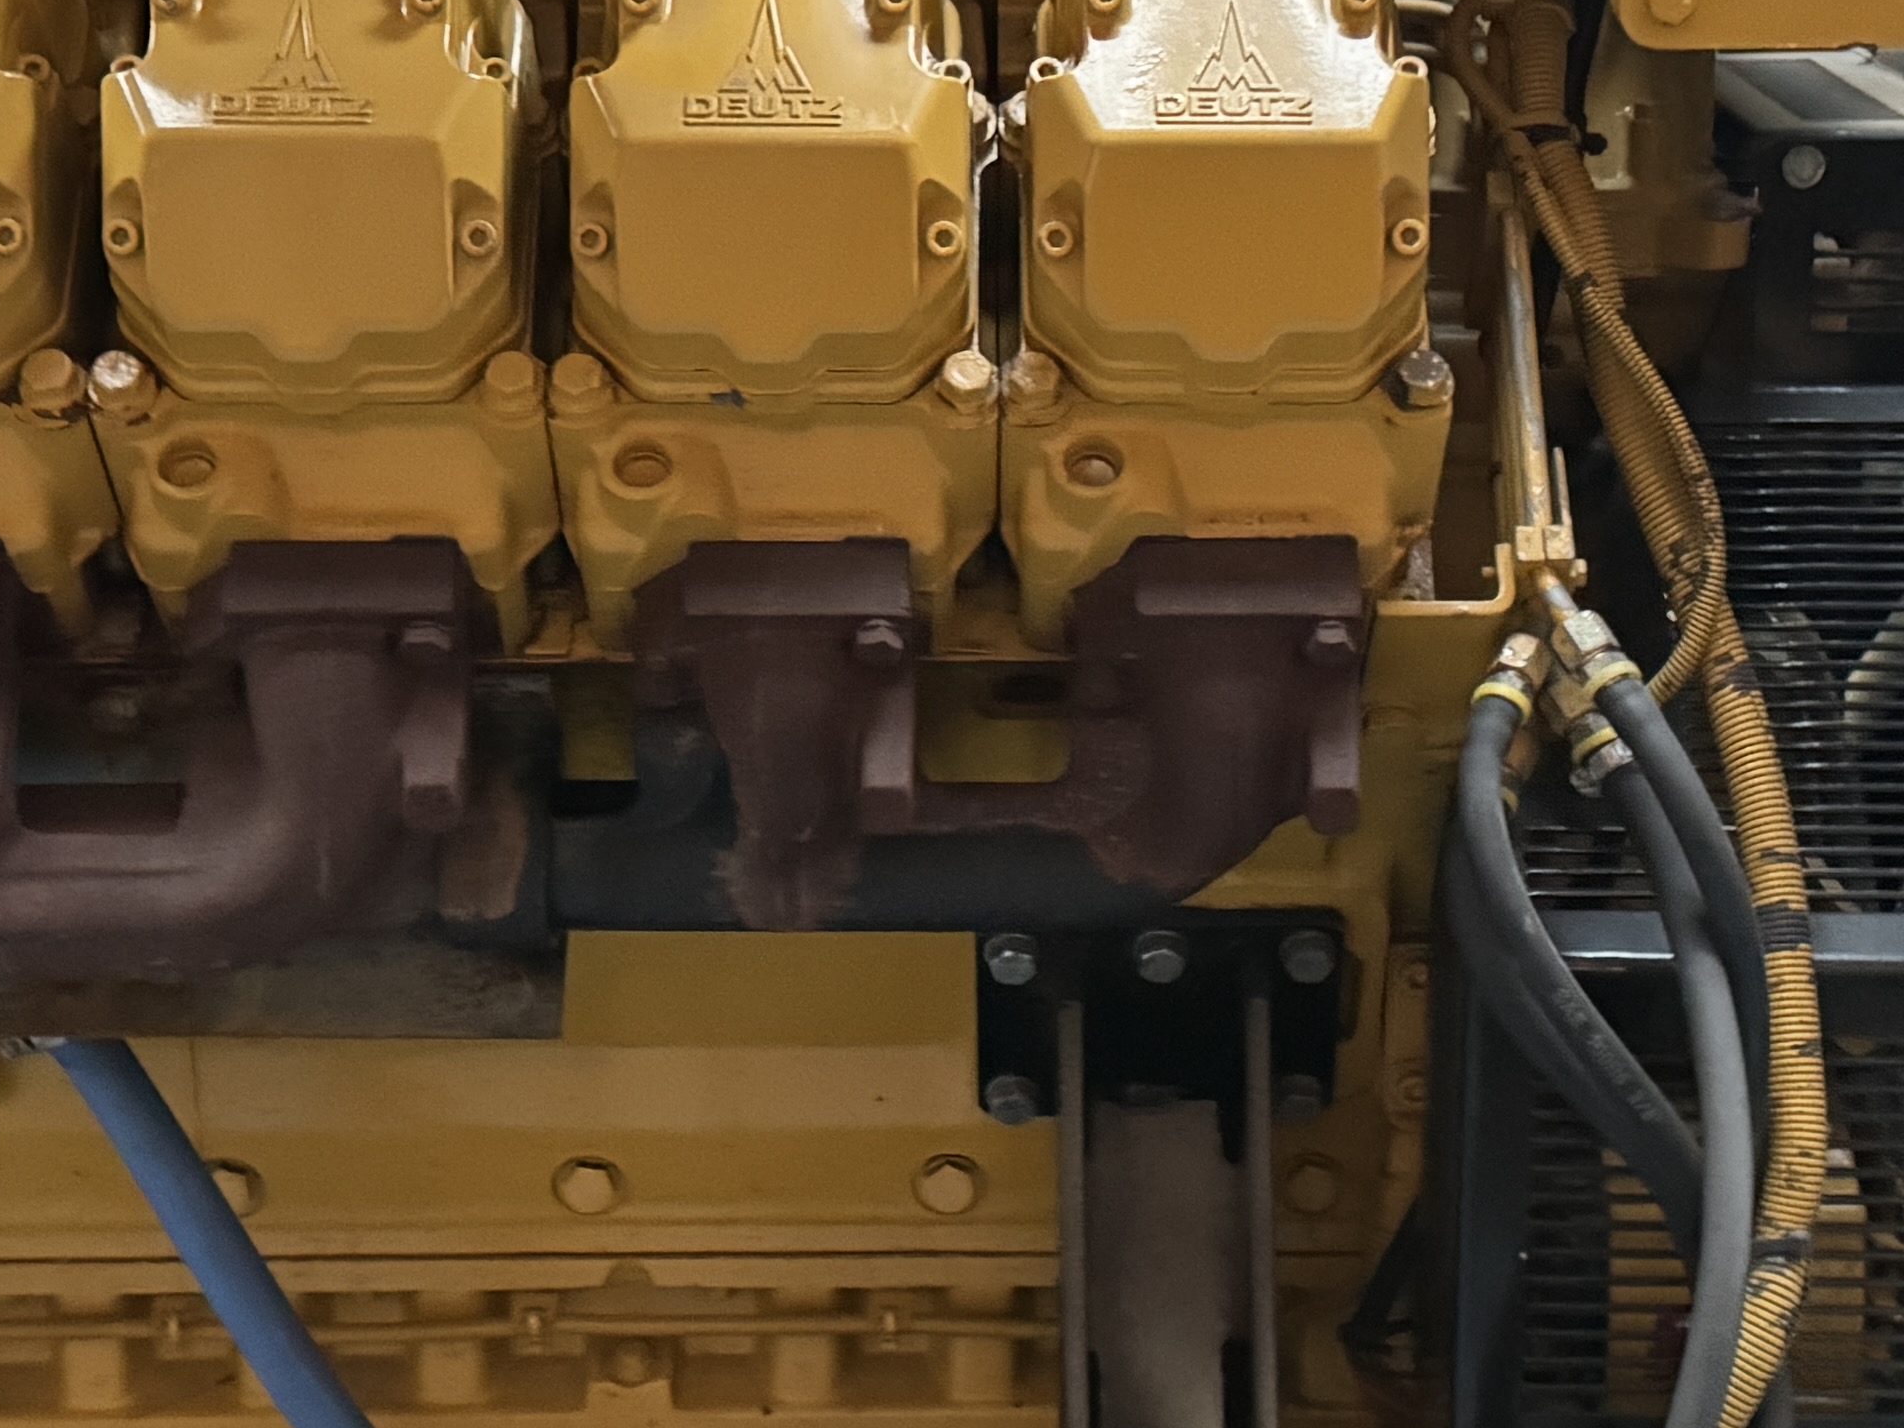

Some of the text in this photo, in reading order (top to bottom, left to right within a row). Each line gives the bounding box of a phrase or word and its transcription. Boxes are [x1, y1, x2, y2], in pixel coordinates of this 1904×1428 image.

[210, 93, 373, 117] DEUTZ
[682, 94, 843, 118] DEUTZ
[1154, 93, 1313, 117] DEUTZ
